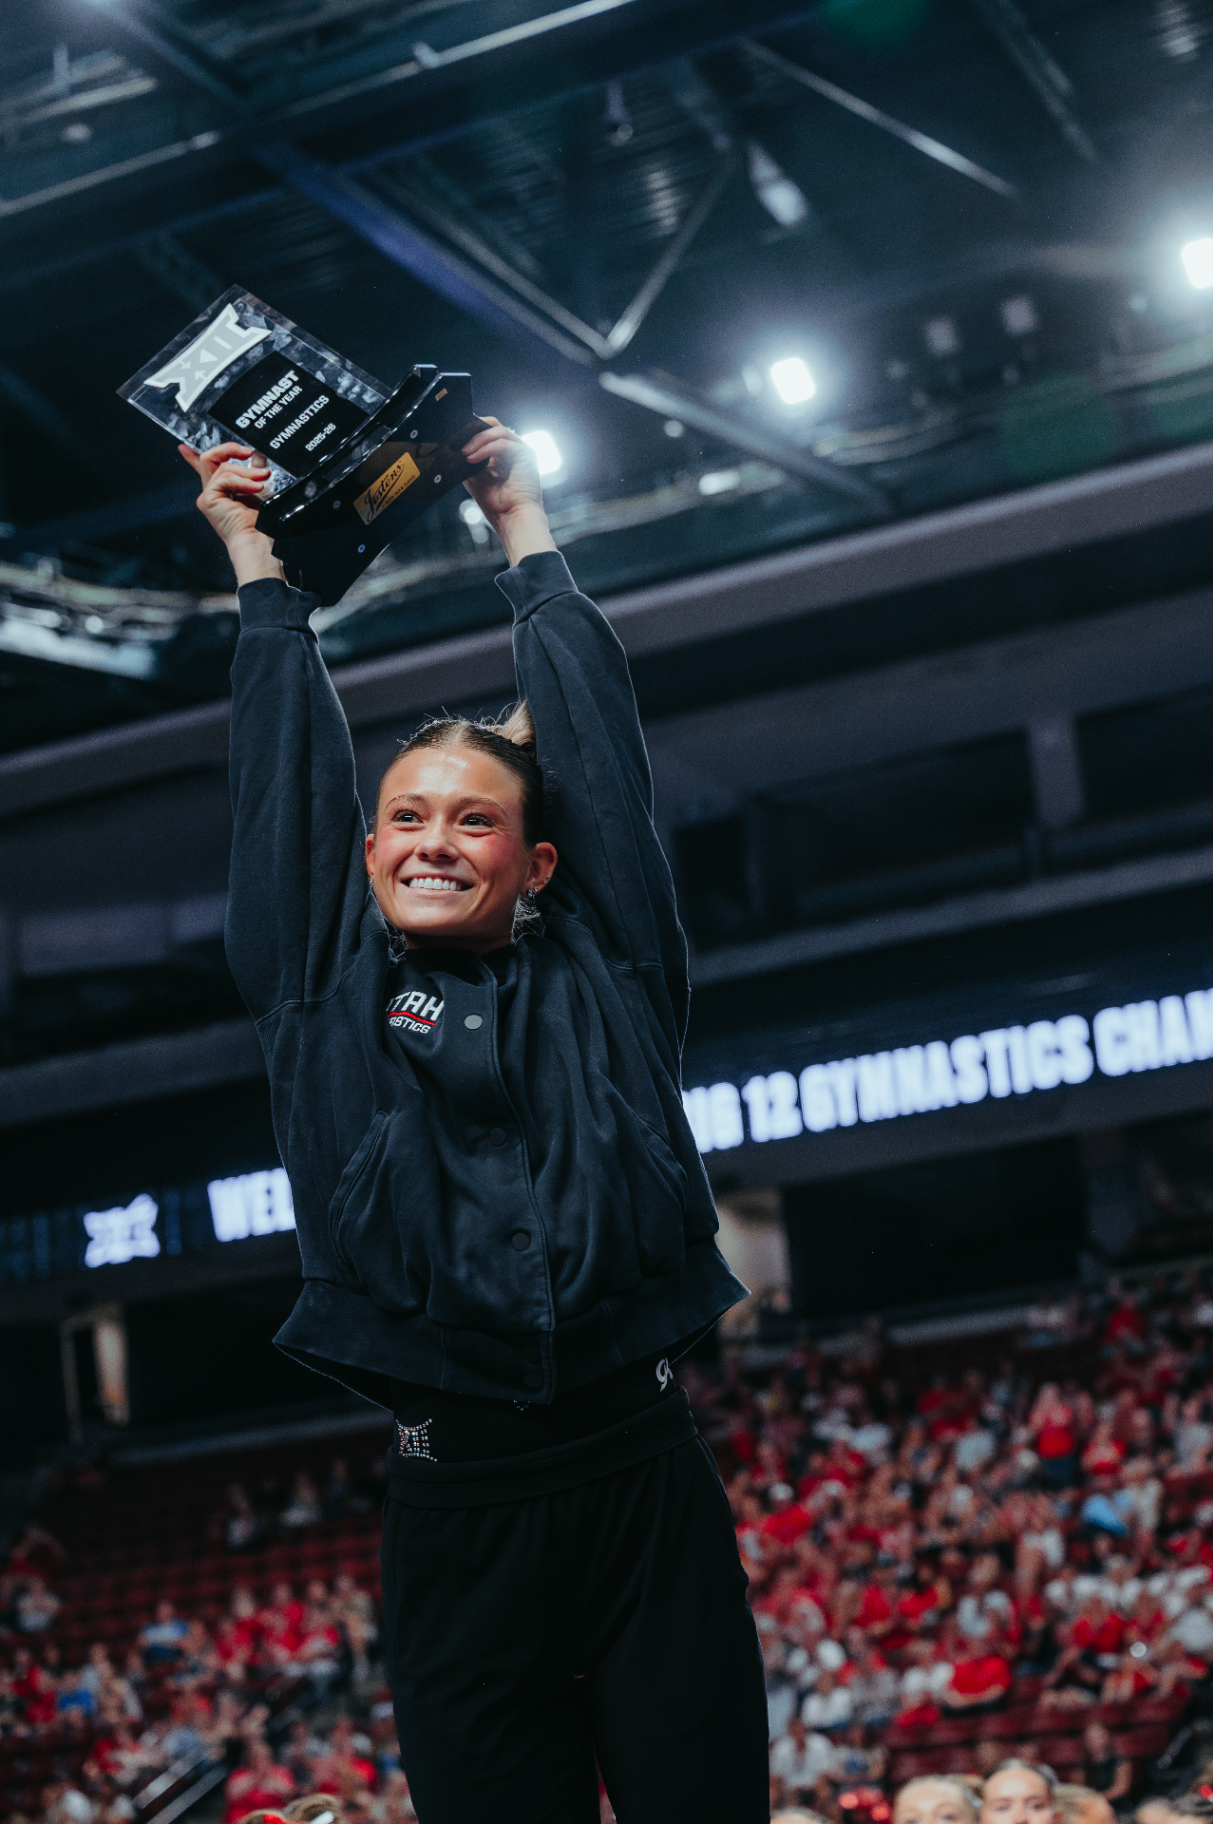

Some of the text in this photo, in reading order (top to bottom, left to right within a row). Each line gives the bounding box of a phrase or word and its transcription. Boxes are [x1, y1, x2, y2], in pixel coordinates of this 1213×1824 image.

[235, 369, 299, 429] GYMNAST
[254, 385, 303, 429] OF THE YEAR
[269, 394, 330, 450] GYMNASTICS
[364, 463, 405, 523] Jostens
[386, 991, 444, 1021] TAH
[741, 1070, 803, 1143] 12
[799, 1014, 1094, 1134] GYMNASTICS
